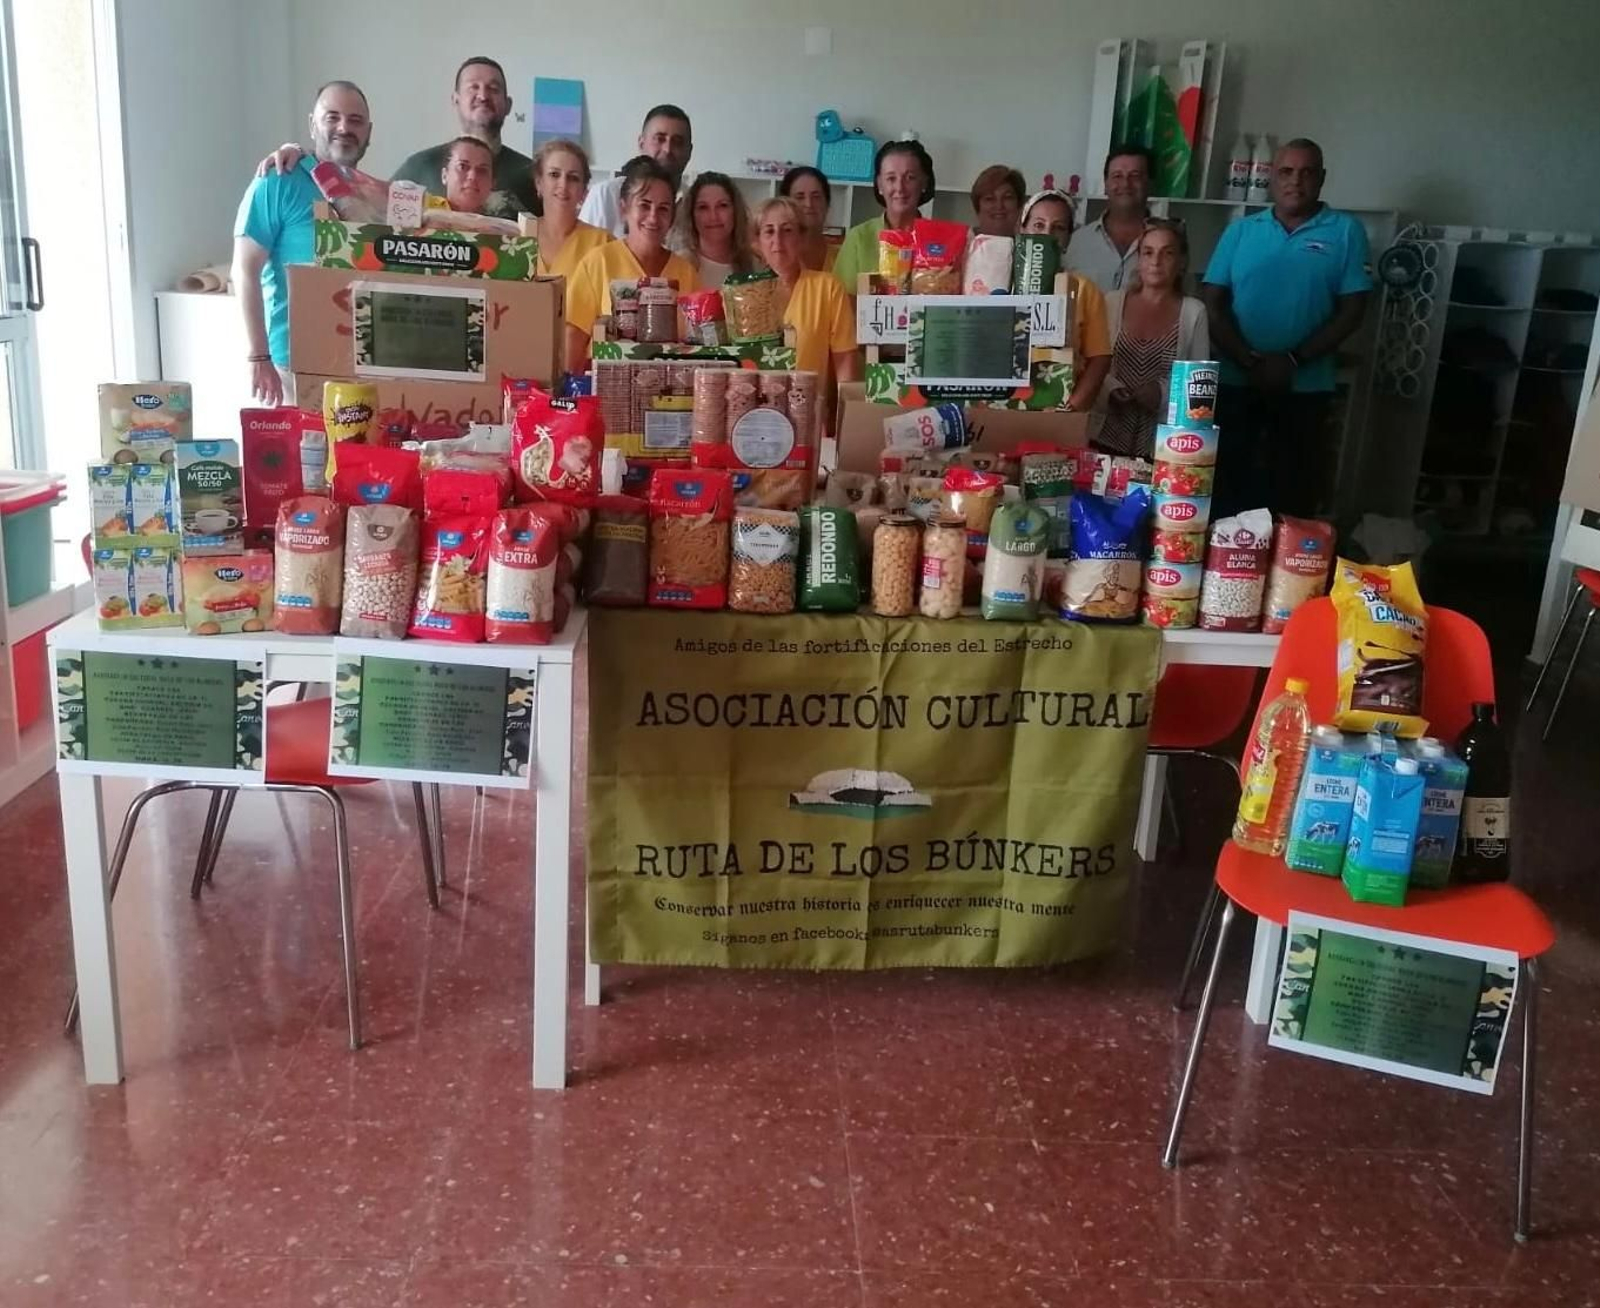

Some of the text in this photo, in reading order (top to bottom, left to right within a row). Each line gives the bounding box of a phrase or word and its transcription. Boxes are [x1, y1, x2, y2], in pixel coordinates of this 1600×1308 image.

[382, 240, 471, 262] PASARÓN
[1029, 243, 1044, 295] EDONDO
[135, 394, 160, 405] Hero
[250, 421, 292, 431] Orlando
[917, 415, 936, 449] SOS
[1170, 435, 1201, 452] apis
[187, 471, 232, 481] MEZCLA
[1164, 502, 1194, 518] apis
[820, 511, 837, 584] REDONDO
[504, 551, 538, 565] EXTRA
[218, 568, 241, 578] Hero
[1149, 567, 1177, 584] apis
[674, 637, 1073, 655] Amigos de las fortificaciones del Estrecho
[636, 686, 1149, 731] ASOCIACIÓN CULTURAL
[1314, 783, 1350, 797] ENTERA
[1424, 797, 1455, 810] NTERA
[633, 830, 1116, 880] RUTA DE LOS BÚNKERS
[653, 894, 1076, 917] Conservar nuestra historia es enriquecer nuestra mente
[770, 931, 789, 944] en
